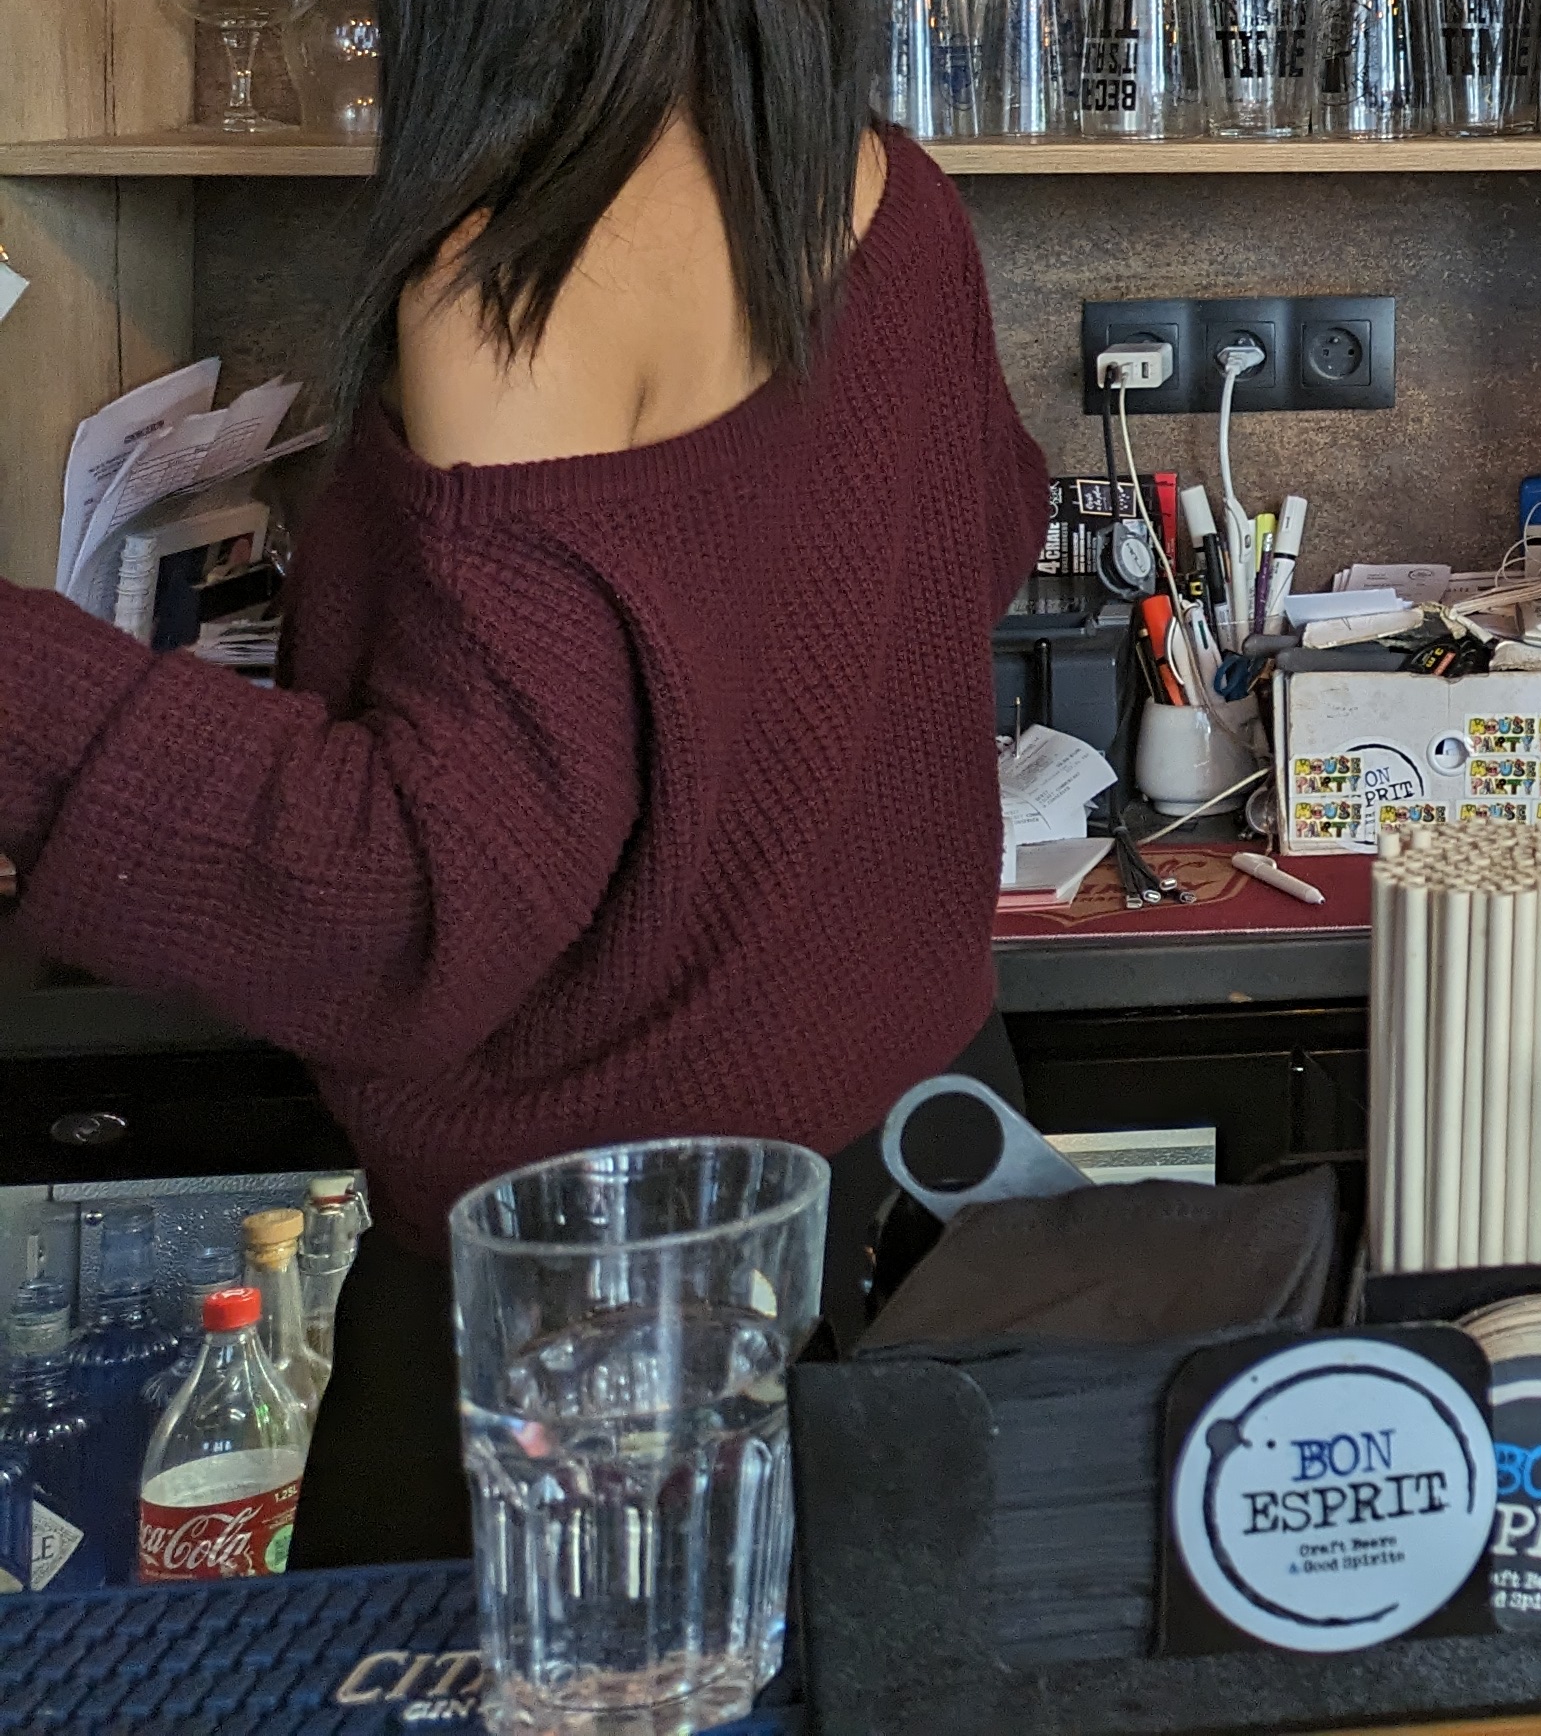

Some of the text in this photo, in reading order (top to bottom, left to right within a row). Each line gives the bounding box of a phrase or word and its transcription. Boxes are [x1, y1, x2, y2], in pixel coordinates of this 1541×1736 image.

[1037, 561, 1060, 575] 4
[1469, 717, 1535, 734] MOUSE
[1470, 736, 1535, 753] PARTY
[1294, 757, 1361, 775] MOUSE
[1470, 759, 1536, 777] MOUSE
[1295, 776, 1361, 795] PARTY
[1470, 779, 1535, 796] PARTY
[1294, 801, 1362, 820] MOUSE
[1379, 803, 1447, 823] MOUSE
[1460, 803, 1527, 822] MOUSE
[1296, 820, 1361, 838] PARTY
[1292, 1428, 1396, 1482] BON
[1243, 1472, 1448, 1535] ESPRIT
[140, 1505, 262, 1570] ca-Cola
[1300, 1535, 1397, 1557] Craft Beers
[1303, 1558, 1339, 1573] Good
[1342, 1549, 1405, 1569] Spirits
